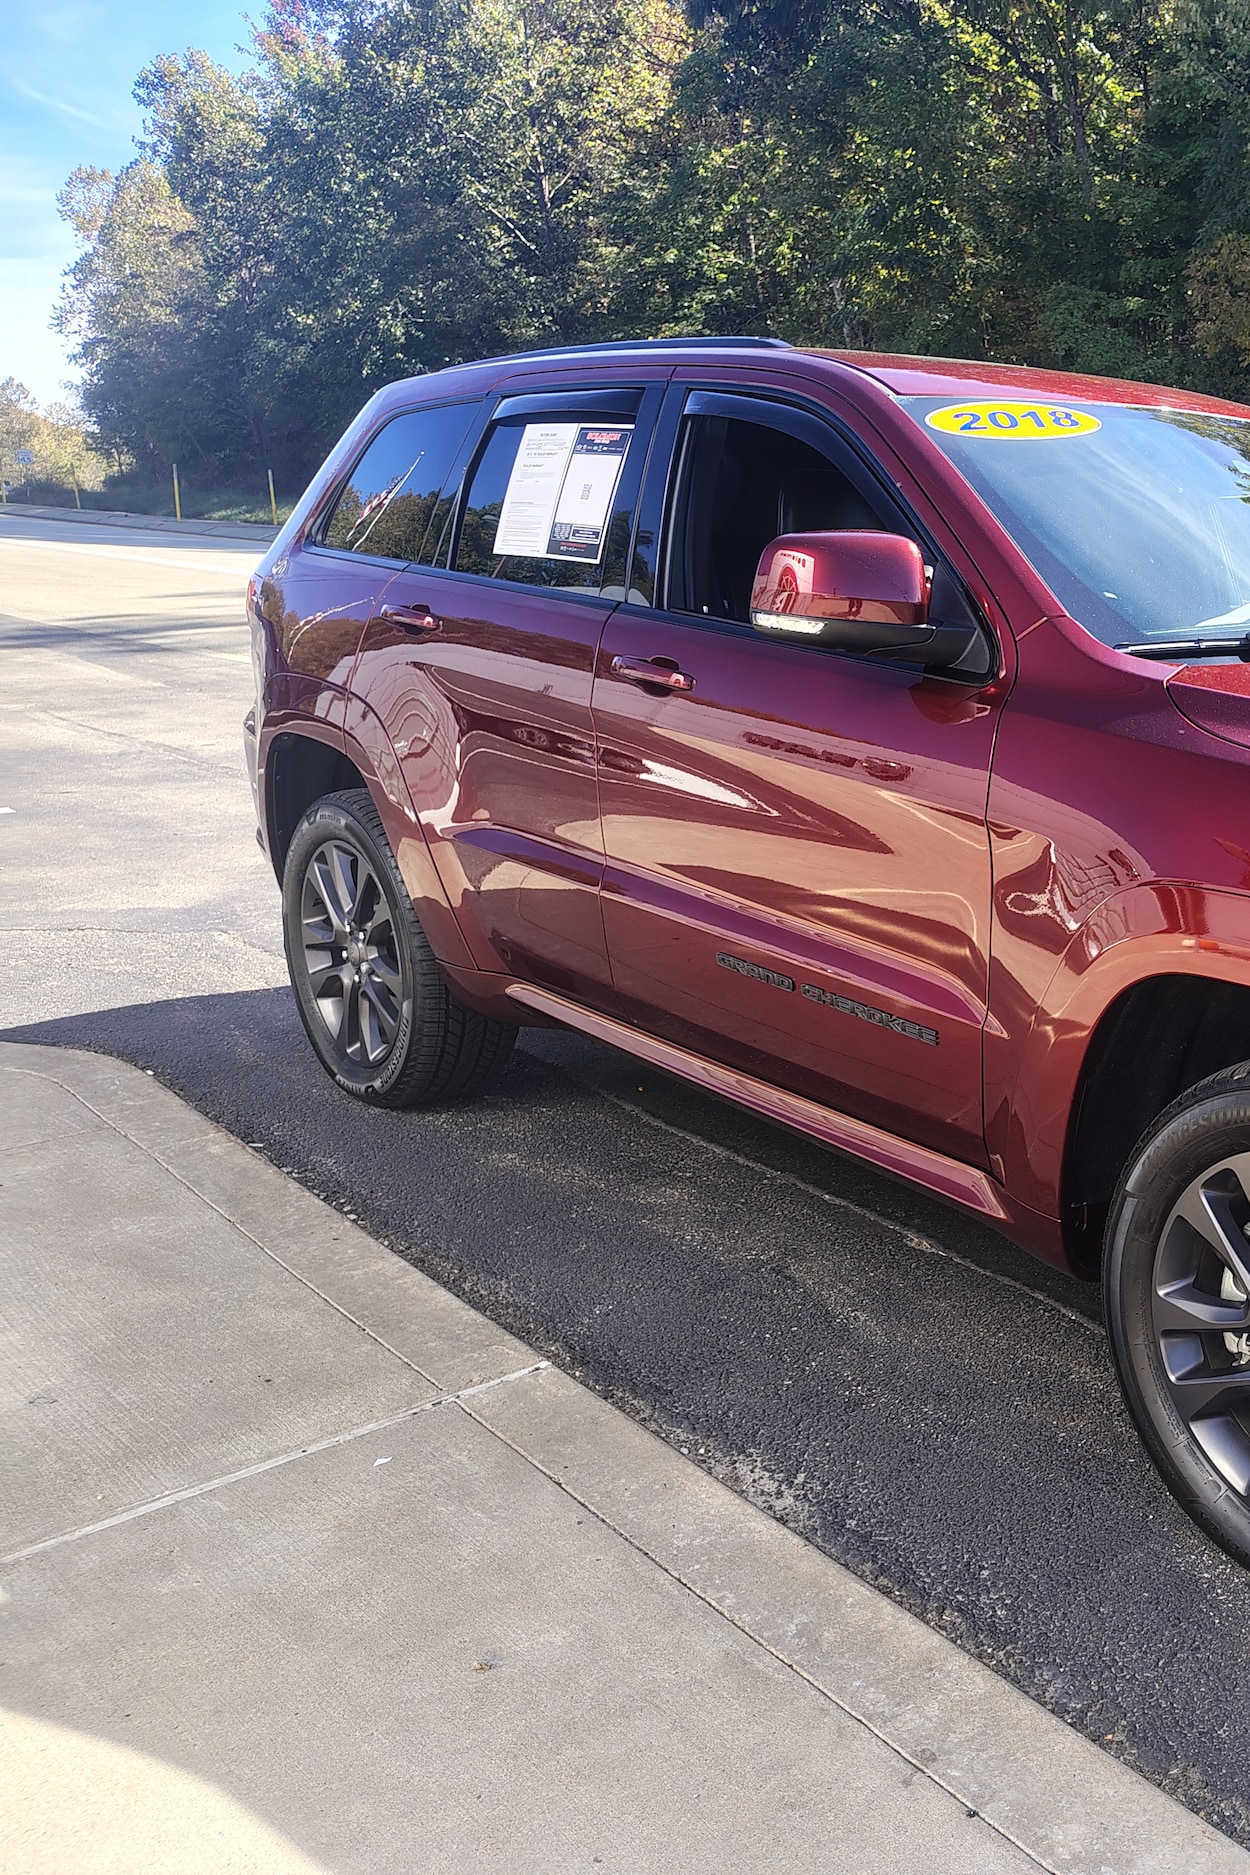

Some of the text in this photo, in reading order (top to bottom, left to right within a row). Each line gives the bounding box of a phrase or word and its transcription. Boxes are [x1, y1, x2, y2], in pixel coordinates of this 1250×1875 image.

[953, 410, 1081, 431] 2018
[716, 951, 941, 1047] GRAND CHEROKEE
